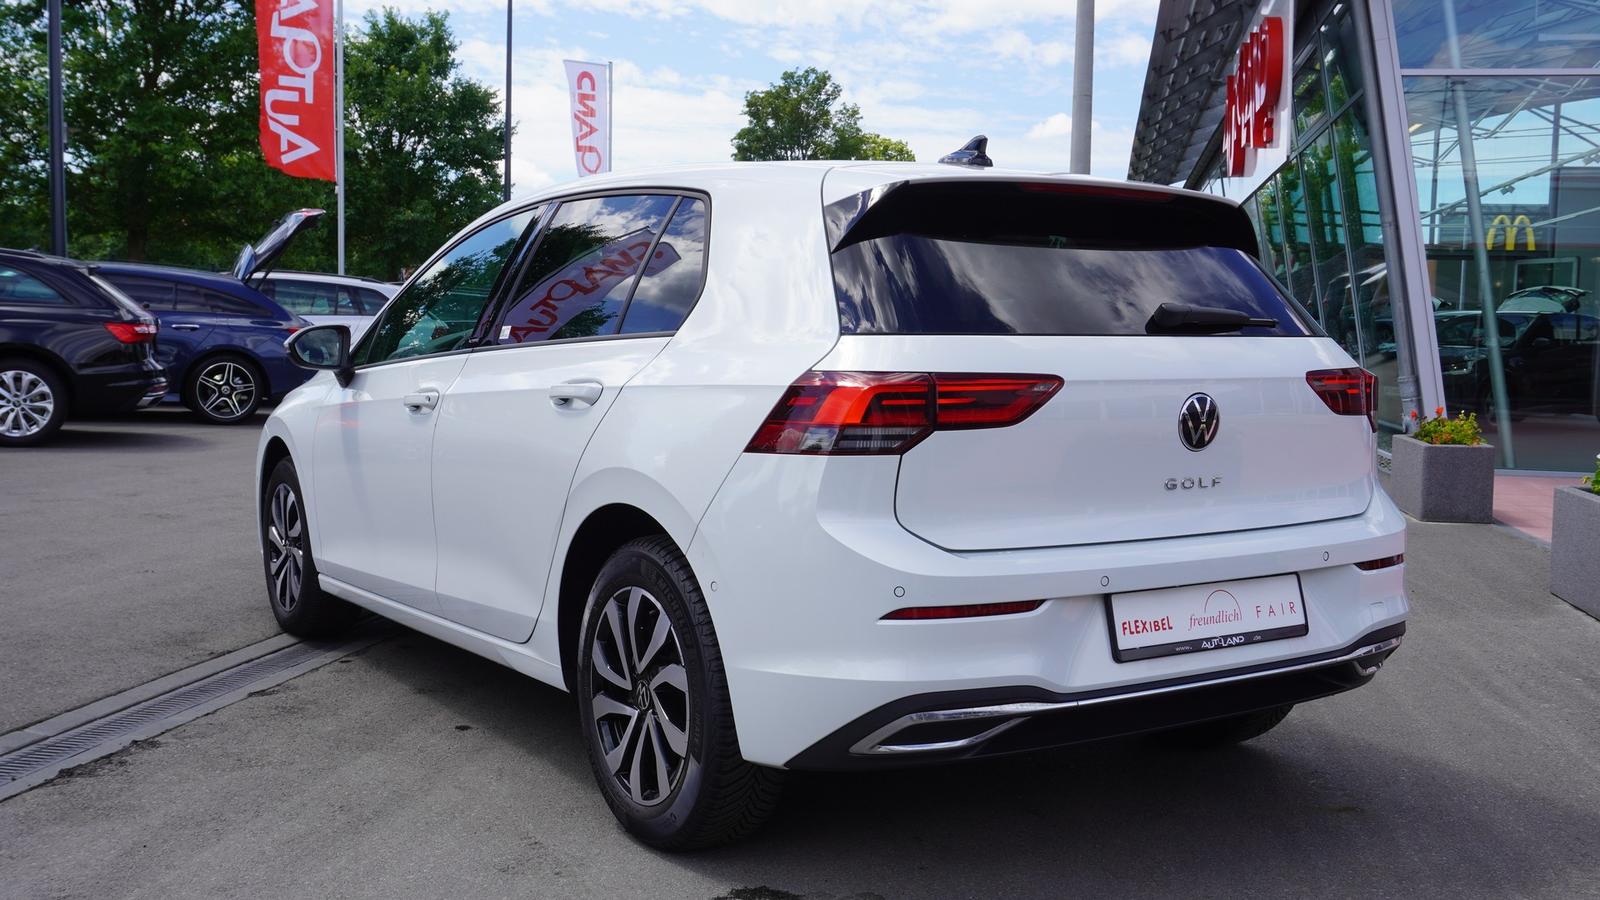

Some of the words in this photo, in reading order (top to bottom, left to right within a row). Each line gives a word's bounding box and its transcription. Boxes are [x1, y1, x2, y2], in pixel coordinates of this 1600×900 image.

[1164, 476, 1222, 490] GOLF
[1121, 616, 1173, 636] FLEXIBEL
[1187, 609, 1240, 631] freundlich
[1255, 601, 1297, 619] FAIR
[1201, 635, 1245, 649] AUTOLAND
